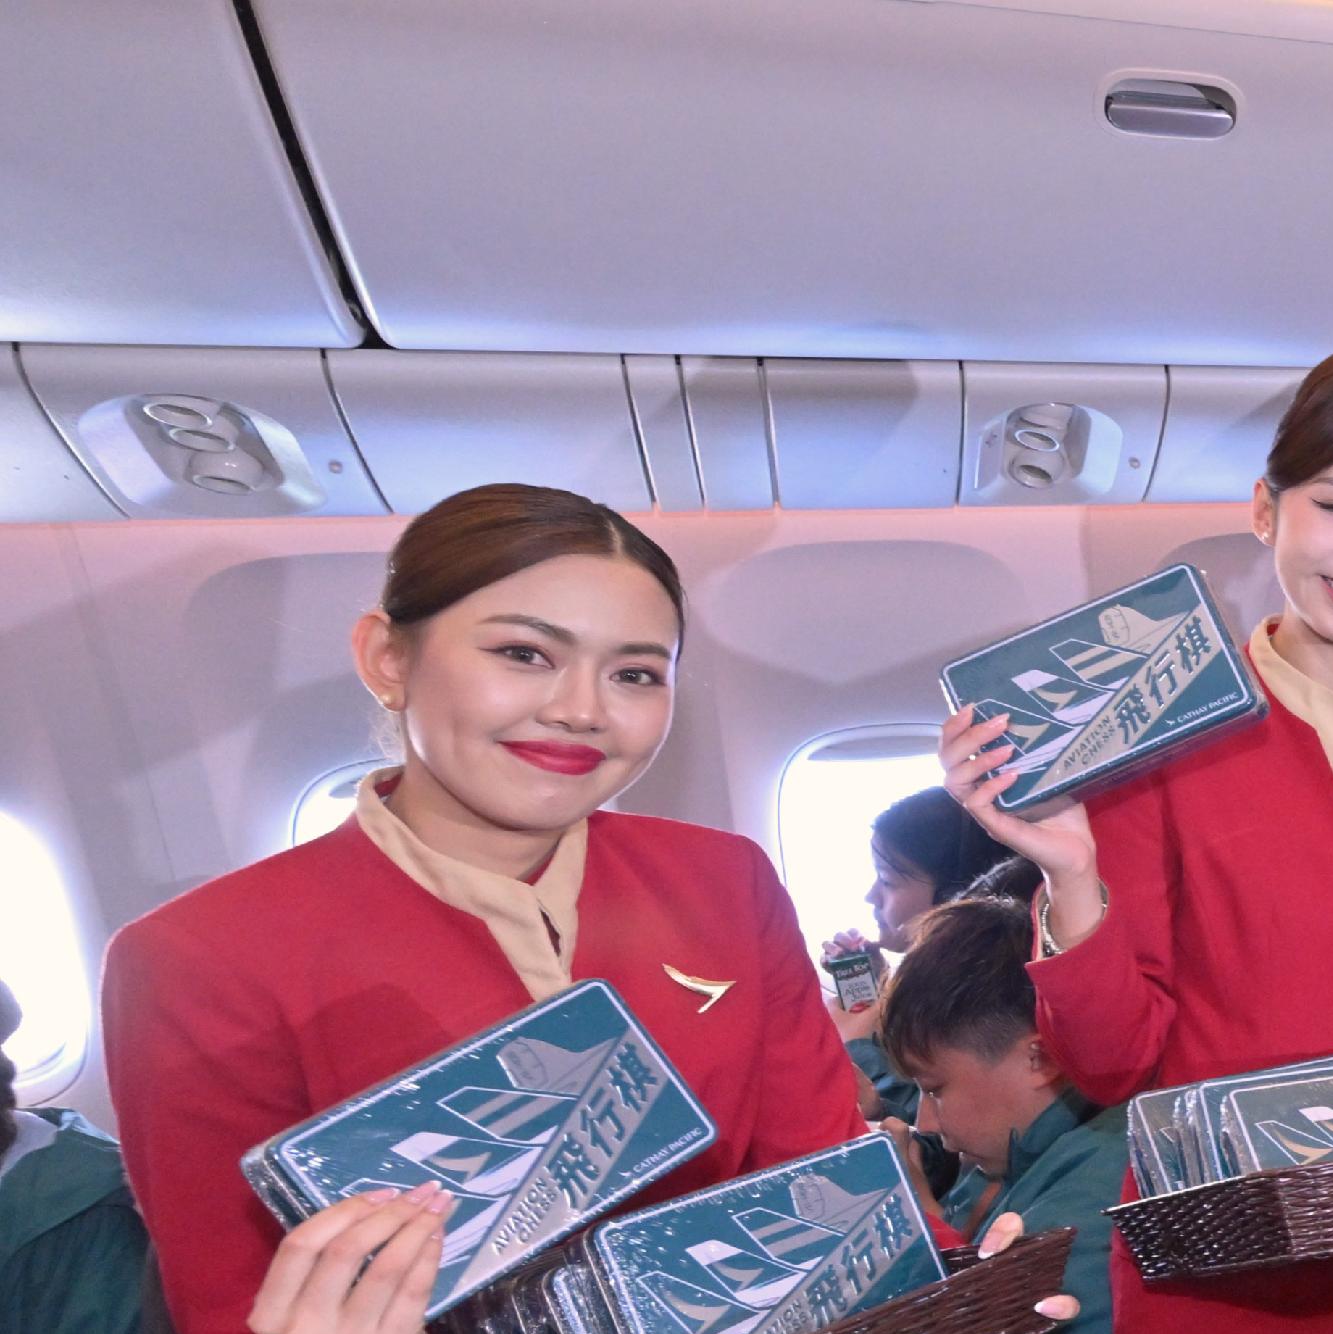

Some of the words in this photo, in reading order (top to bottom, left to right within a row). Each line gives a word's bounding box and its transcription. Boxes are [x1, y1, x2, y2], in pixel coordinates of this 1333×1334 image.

[1114, 616, 1212, 746] 飛行棋
[1177, 704, 1208, 723] CATHAY
[1208, 691, 1239, 710] PACIFIC
[1063, 714, 1111, 771] AVIATION
[549, 1043, 658, 1209] 飛行棋
[633, 1146, 669, 1173] CATHAY
[668, 1127, 702, 1152] PACIFIC
[491, 1177, 548, 1256] AVIATION
[803, 1193, 913, 1329] 飛行棋
